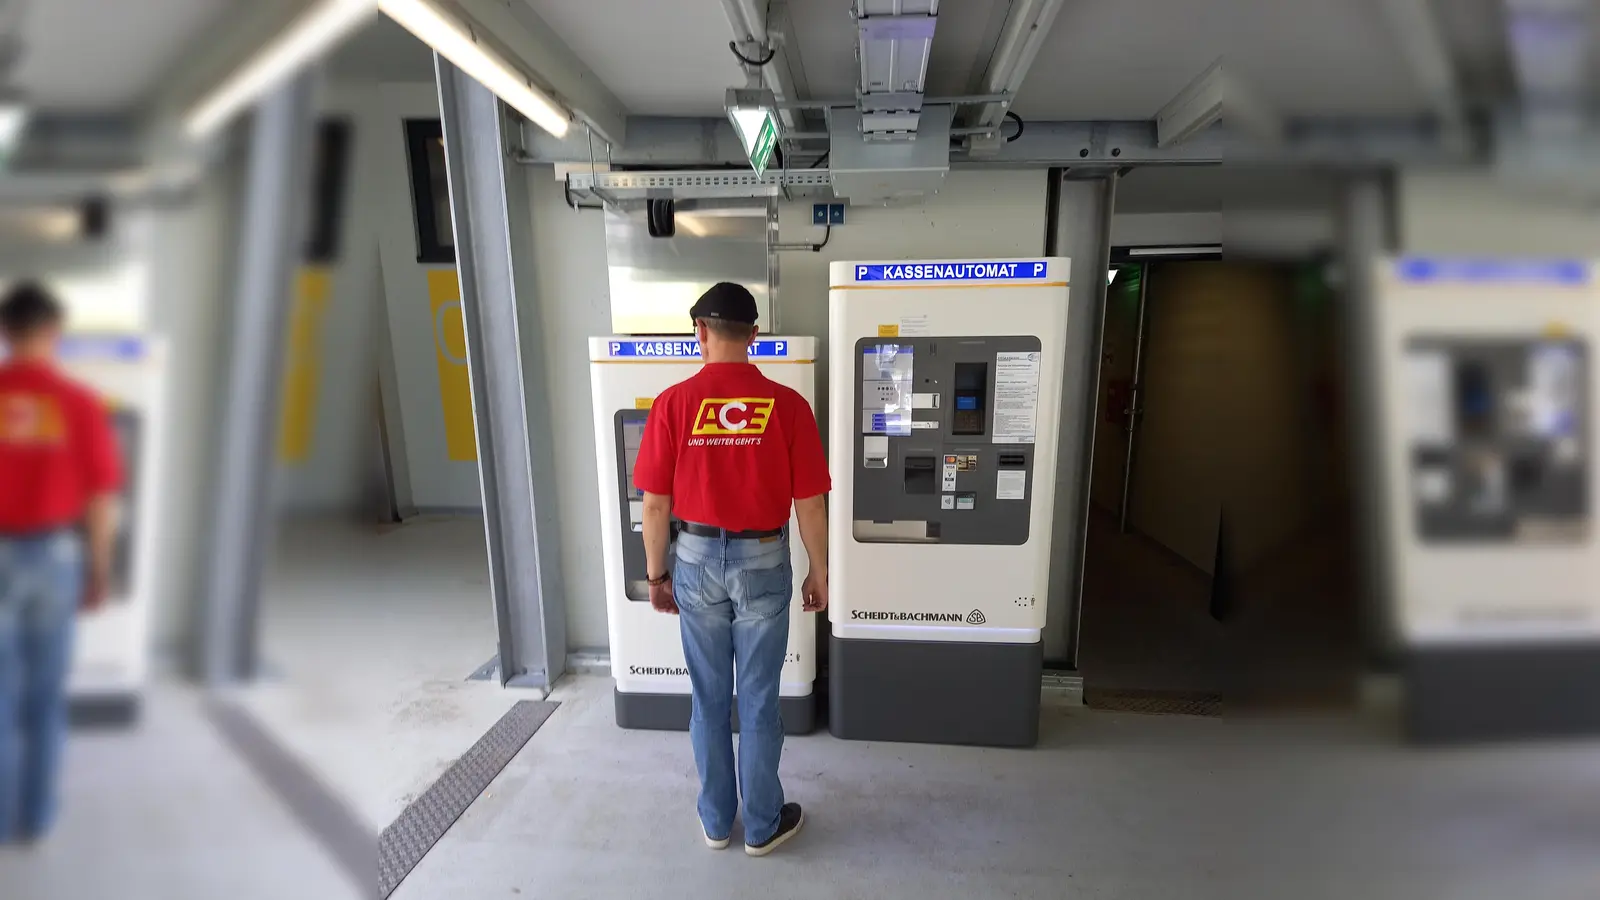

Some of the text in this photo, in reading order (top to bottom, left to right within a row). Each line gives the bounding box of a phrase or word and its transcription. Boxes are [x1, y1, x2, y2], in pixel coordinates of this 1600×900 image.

[858, 263, 1044, 280] P KASSENAUTOMAT P
[612, 342, 784, 356] P KASSENAAT P
[697, 400, 771, 431] ACE
[688, 437, 762, 446] UND WEITER GEHT'S
